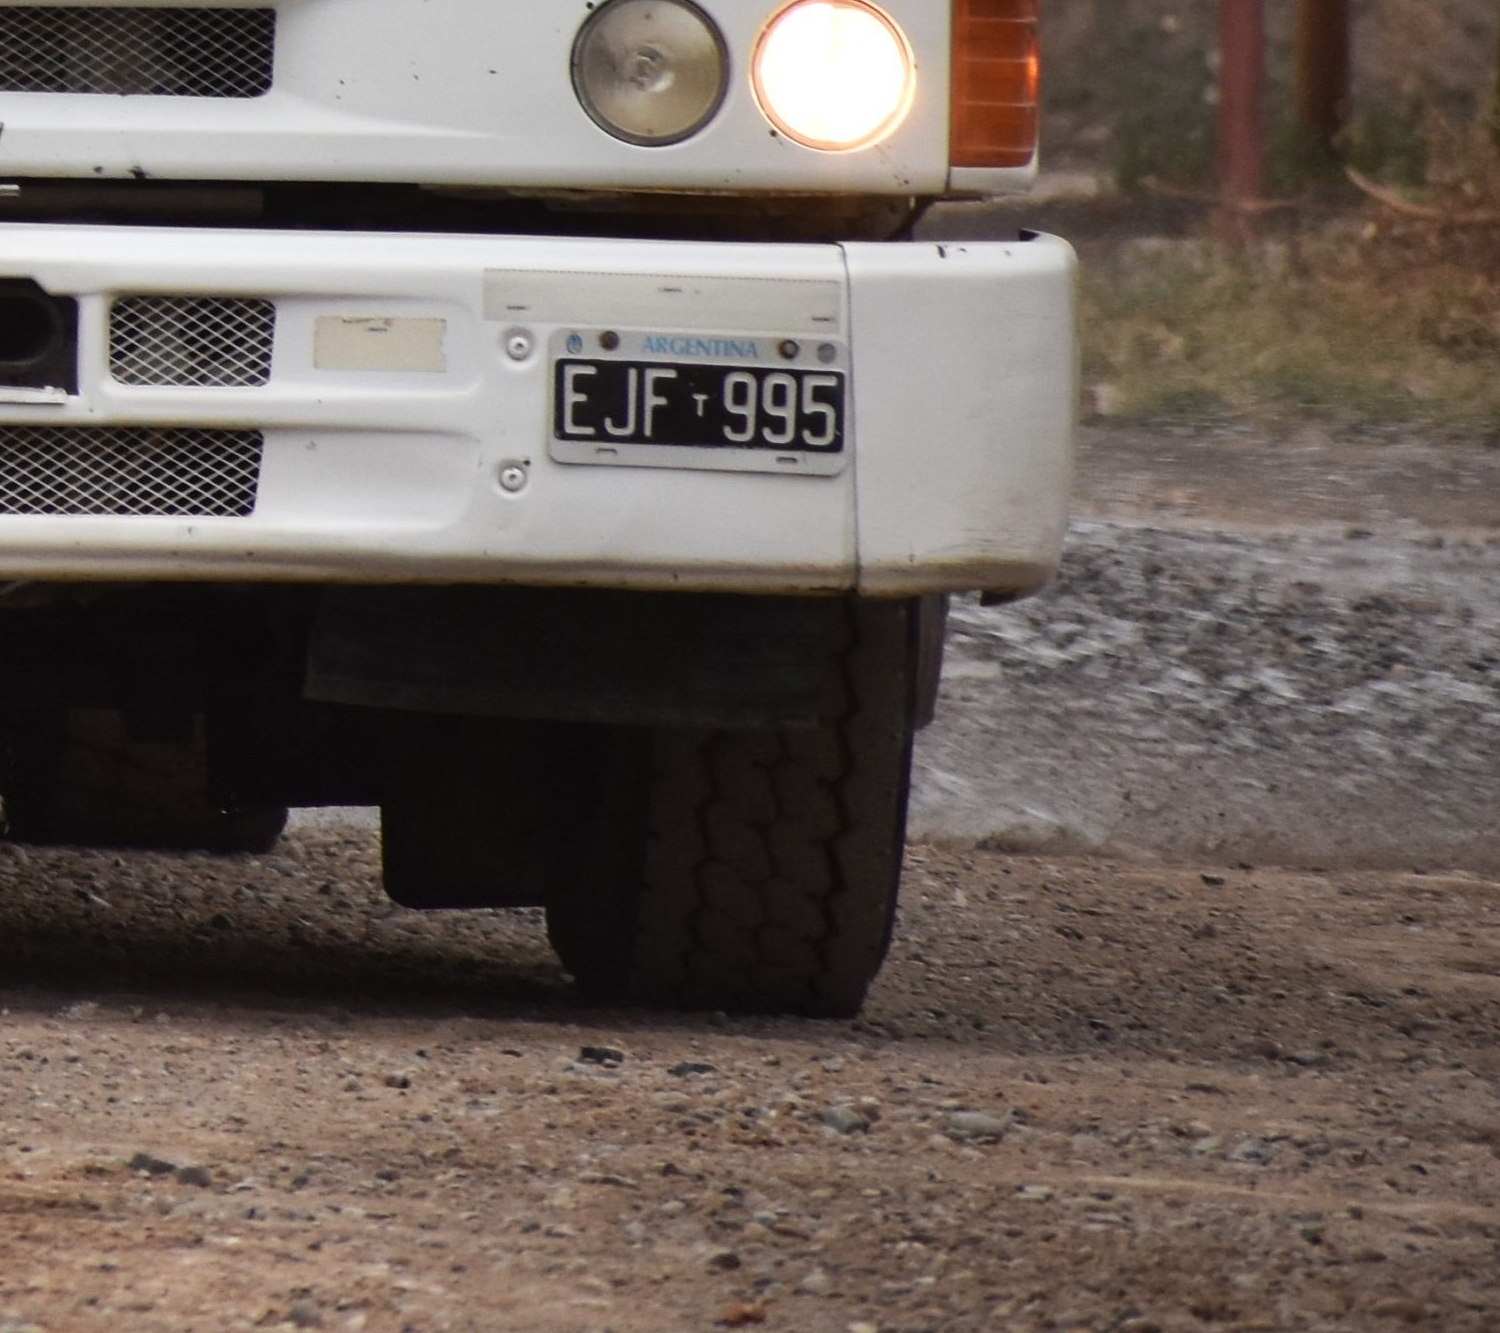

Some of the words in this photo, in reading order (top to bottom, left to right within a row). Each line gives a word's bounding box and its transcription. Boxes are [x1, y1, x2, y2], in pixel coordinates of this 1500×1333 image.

[640, 335, 760, 359] ARGENTINA
[562, 364, 679, 437] EJF
[722, 371, 839, 446] 995
